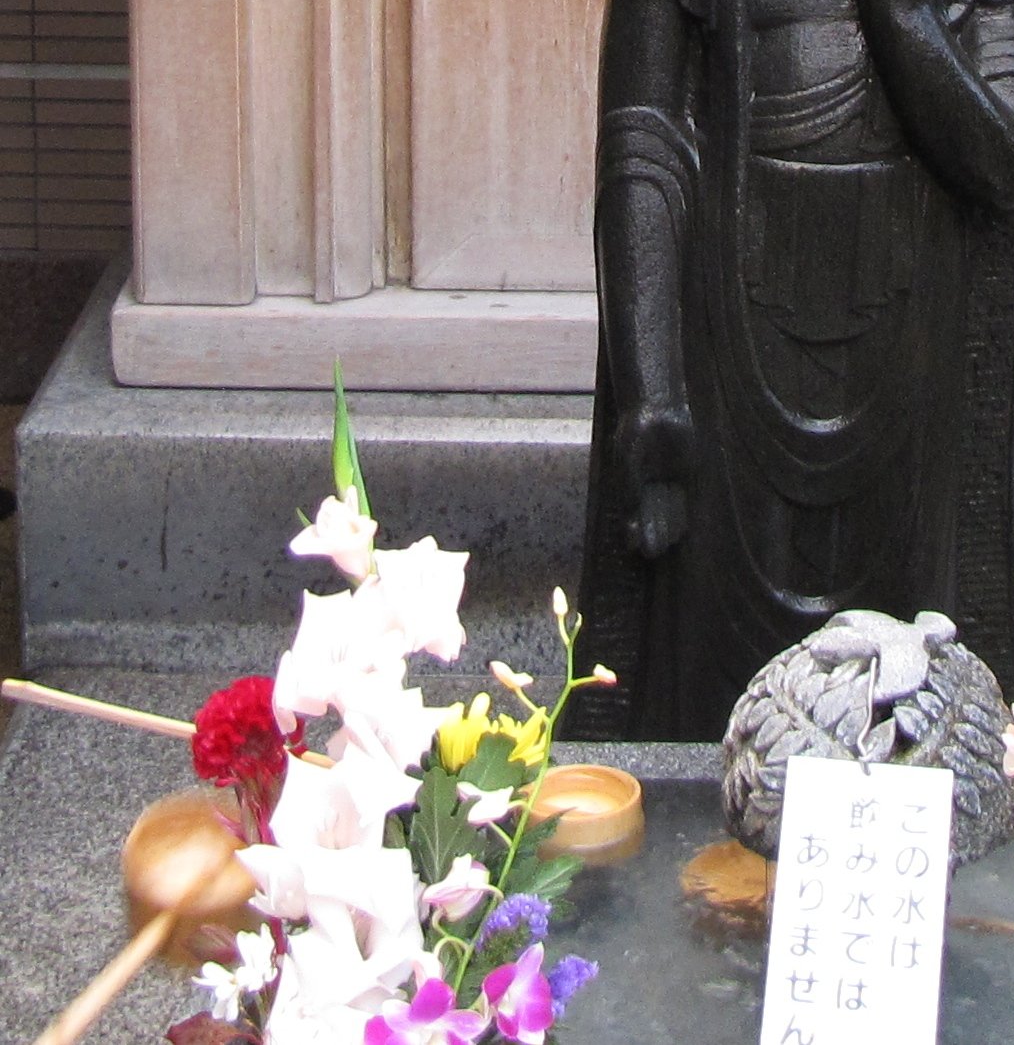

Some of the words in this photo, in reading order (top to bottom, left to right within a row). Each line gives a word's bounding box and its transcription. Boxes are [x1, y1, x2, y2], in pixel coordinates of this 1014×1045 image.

[781, 833, 829, 1045] ありません
[836, 798, 879, 1010] 飲み水では
[892, 804, 929, 969] この水は
